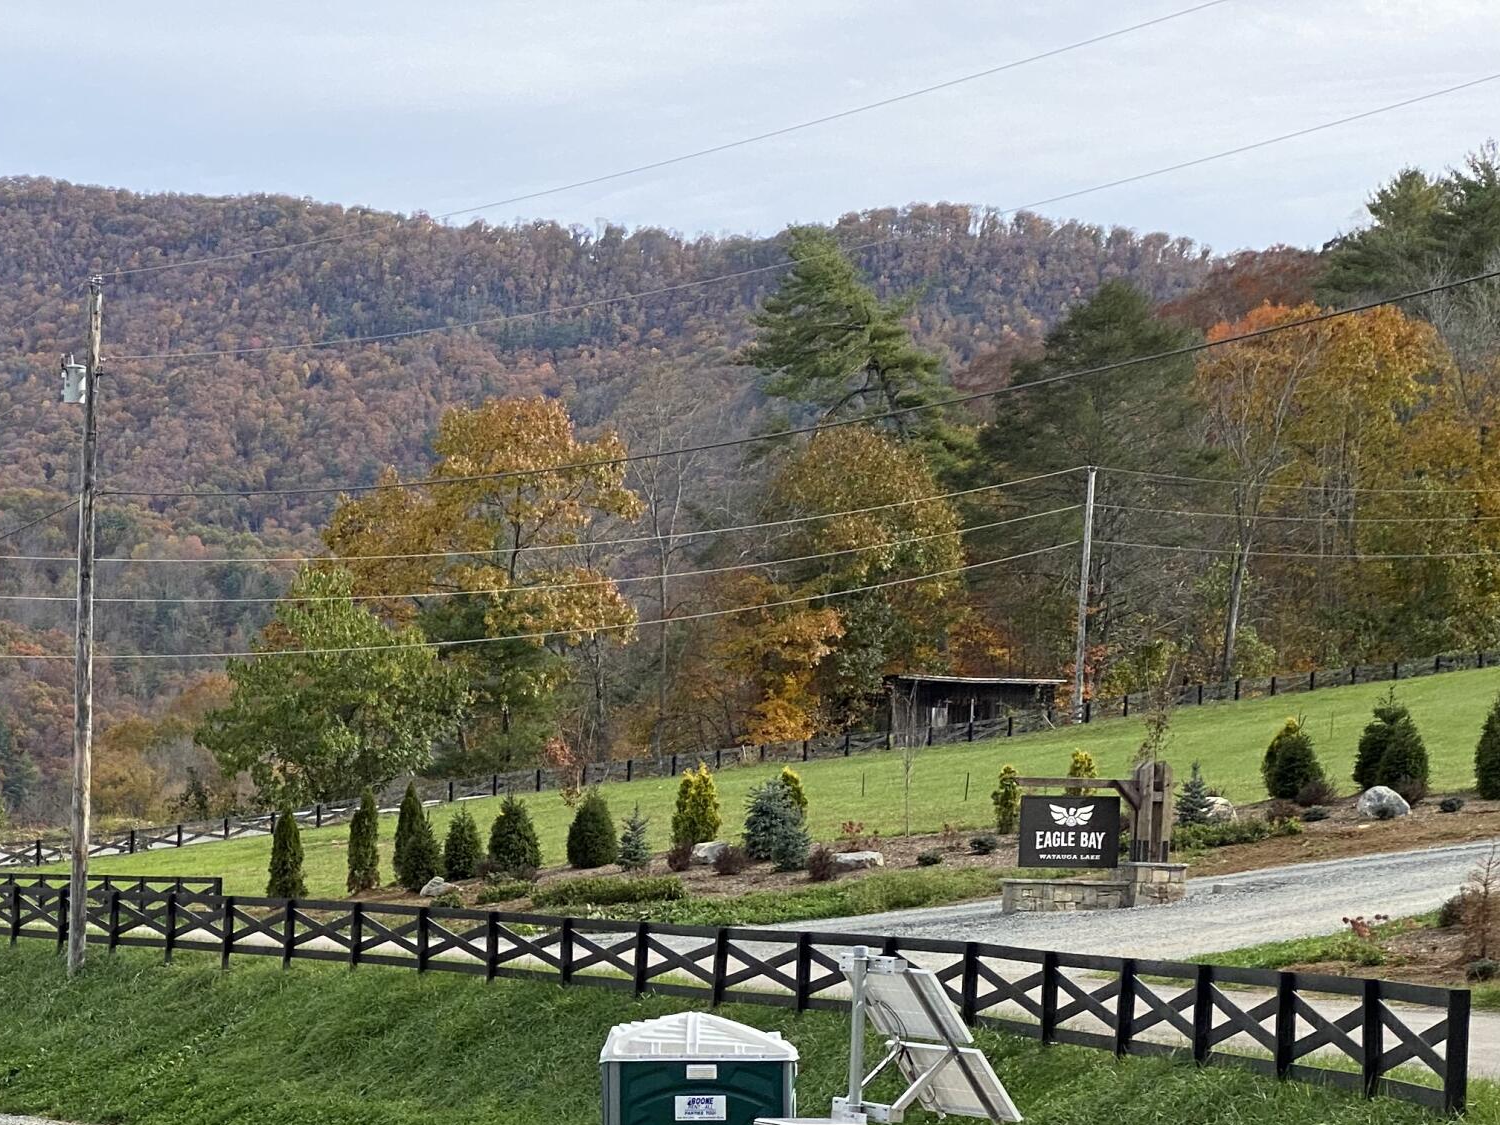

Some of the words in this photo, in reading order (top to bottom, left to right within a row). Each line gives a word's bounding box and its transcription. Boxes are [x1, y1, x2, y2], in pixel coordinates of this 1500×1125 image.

[1035, 831, 1076, 850] EAGLE
[1080, 831, 1106, 850] BAY
[691, 1097, 714, 1105] BOONE
